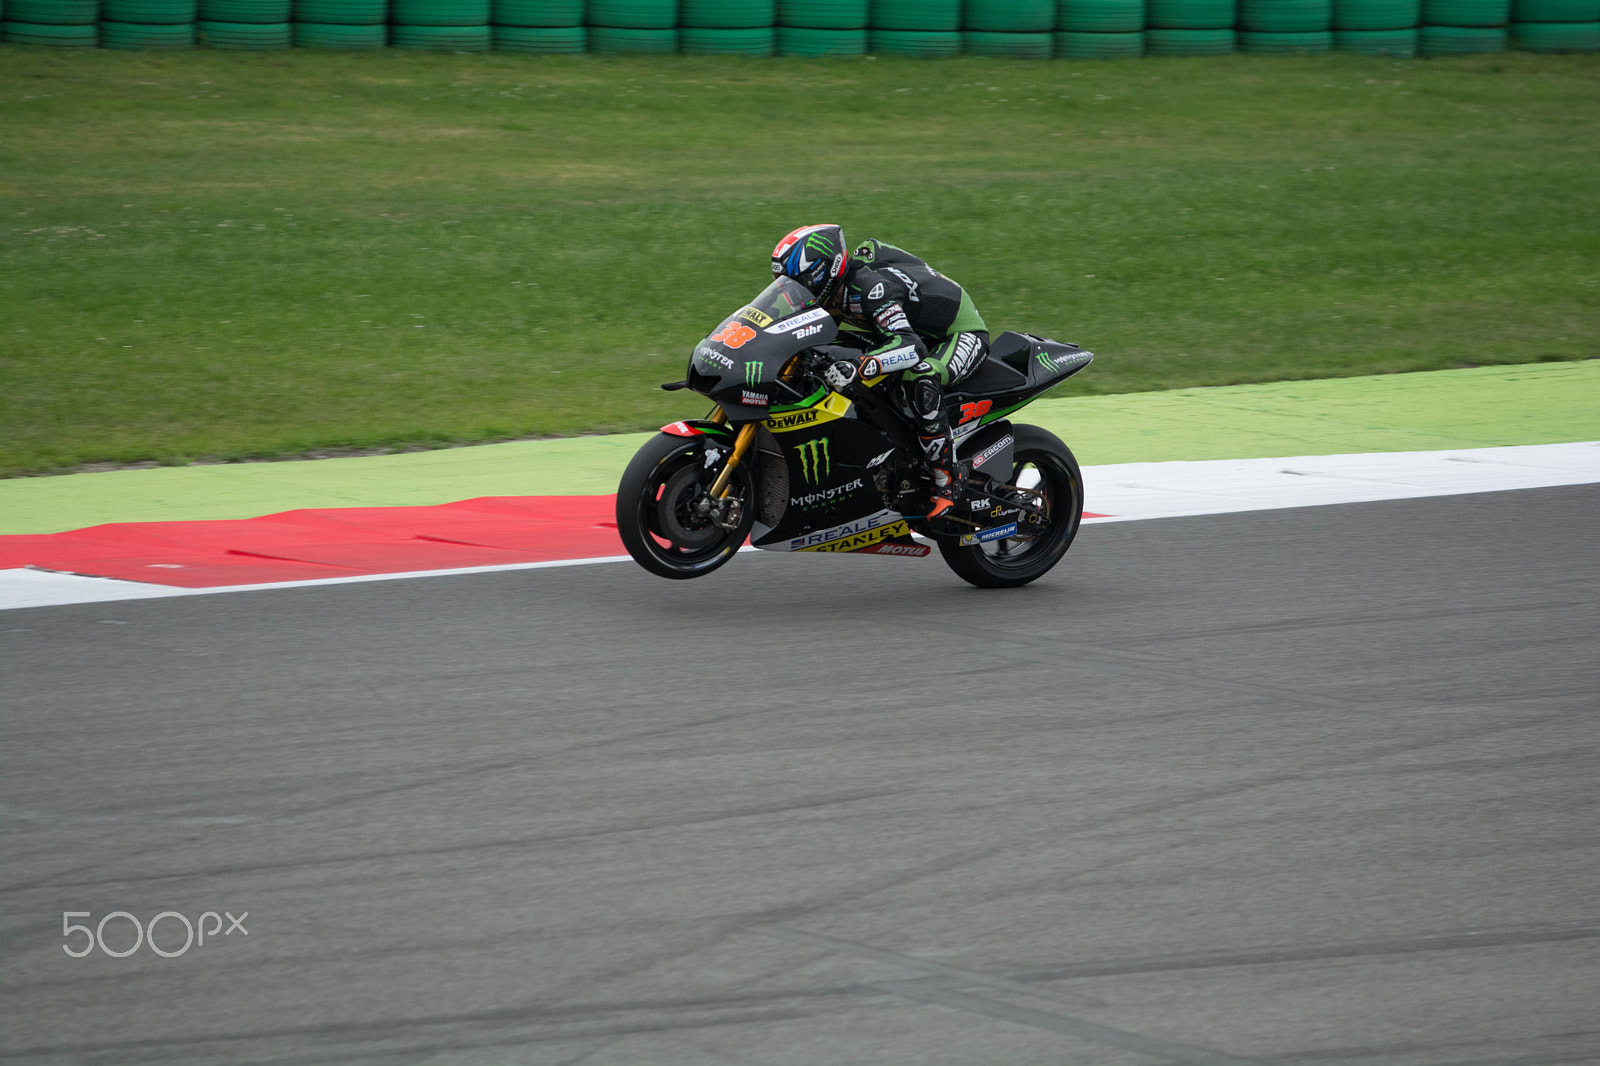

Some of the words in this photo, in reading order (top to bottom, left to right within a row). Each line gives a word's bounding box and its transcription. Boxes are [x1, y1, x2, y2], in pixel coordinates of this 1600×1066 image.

[786, 311, 822, 328] REALE
[710, 321, 757, 349] 38
[791, 323, 823, 340] Bihr
[881, 351, 917, 367] REALE
[741, 389, 768, 400] YAMAHA
[742, 396, 768, 405] MOTUL
[958, 399, 993, 425] 38
[790, 478, 864, 507] MONSTER
[802, 493, 854, 512] ENERGY
[970, 497, 991, 512] RK
[808, 516, 881, 545] REALE
[816, 522, 904, 552] STANLEY
[981, 525, 1016, 541] MICHELIN
[877, 544, 926, 555] MOTUL
